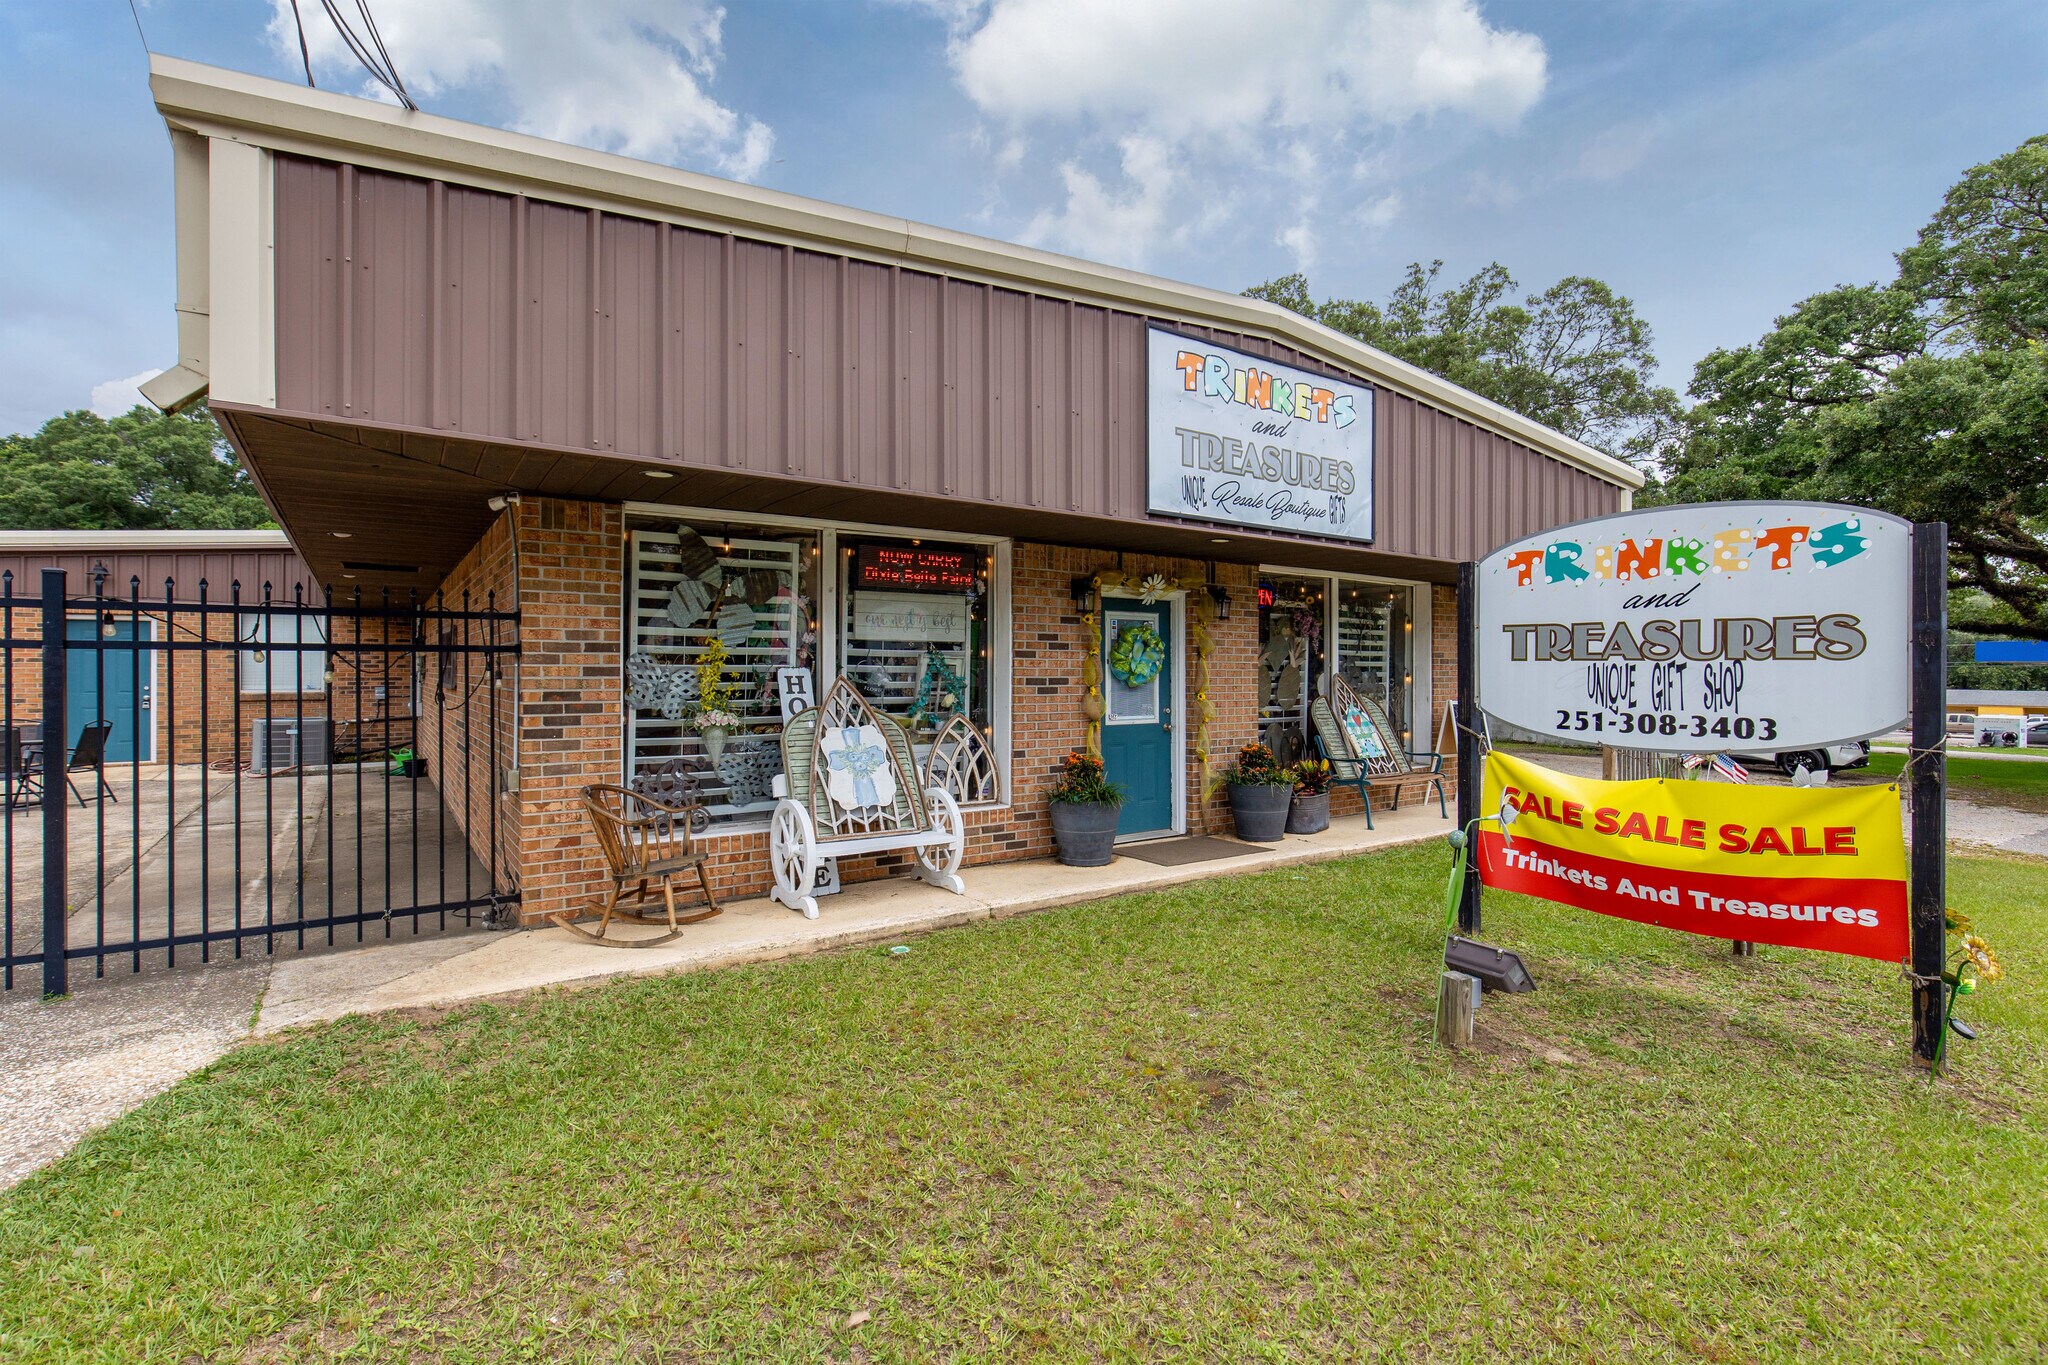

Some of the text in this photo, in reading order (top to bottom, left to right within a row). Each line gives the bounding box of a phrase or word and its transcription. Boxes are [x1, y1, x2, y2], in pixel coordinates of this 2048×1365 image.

[1176, 350, 1357, 430] TRINKETS
[1252, 420, 1292, 438] and
[1175, 426, 1356, 496] TREASURES
[1181, 475, 1208, 511] UNIQUE
[1211, 480, 1264, 514] Resale
[1265, 489, 1327, 524] Boutique
[1506, 518, 1873, 587] TRINKETS
[1622, 582, 1700, 610] and
[1502, 613, 1867, 662] TREASURES
[1587, 662, 1637, 715] UNIQUE
[1651, 660, 1687, 713] GIFT
[1703, 659, 1744, 714] SHOP
[1556, 709, 1778, 741] 251-308-3403
[1504, 786, 1858, 856] SALE SALE SALE
[1502, 847, 1879, 928] Trinkets And Treasures
